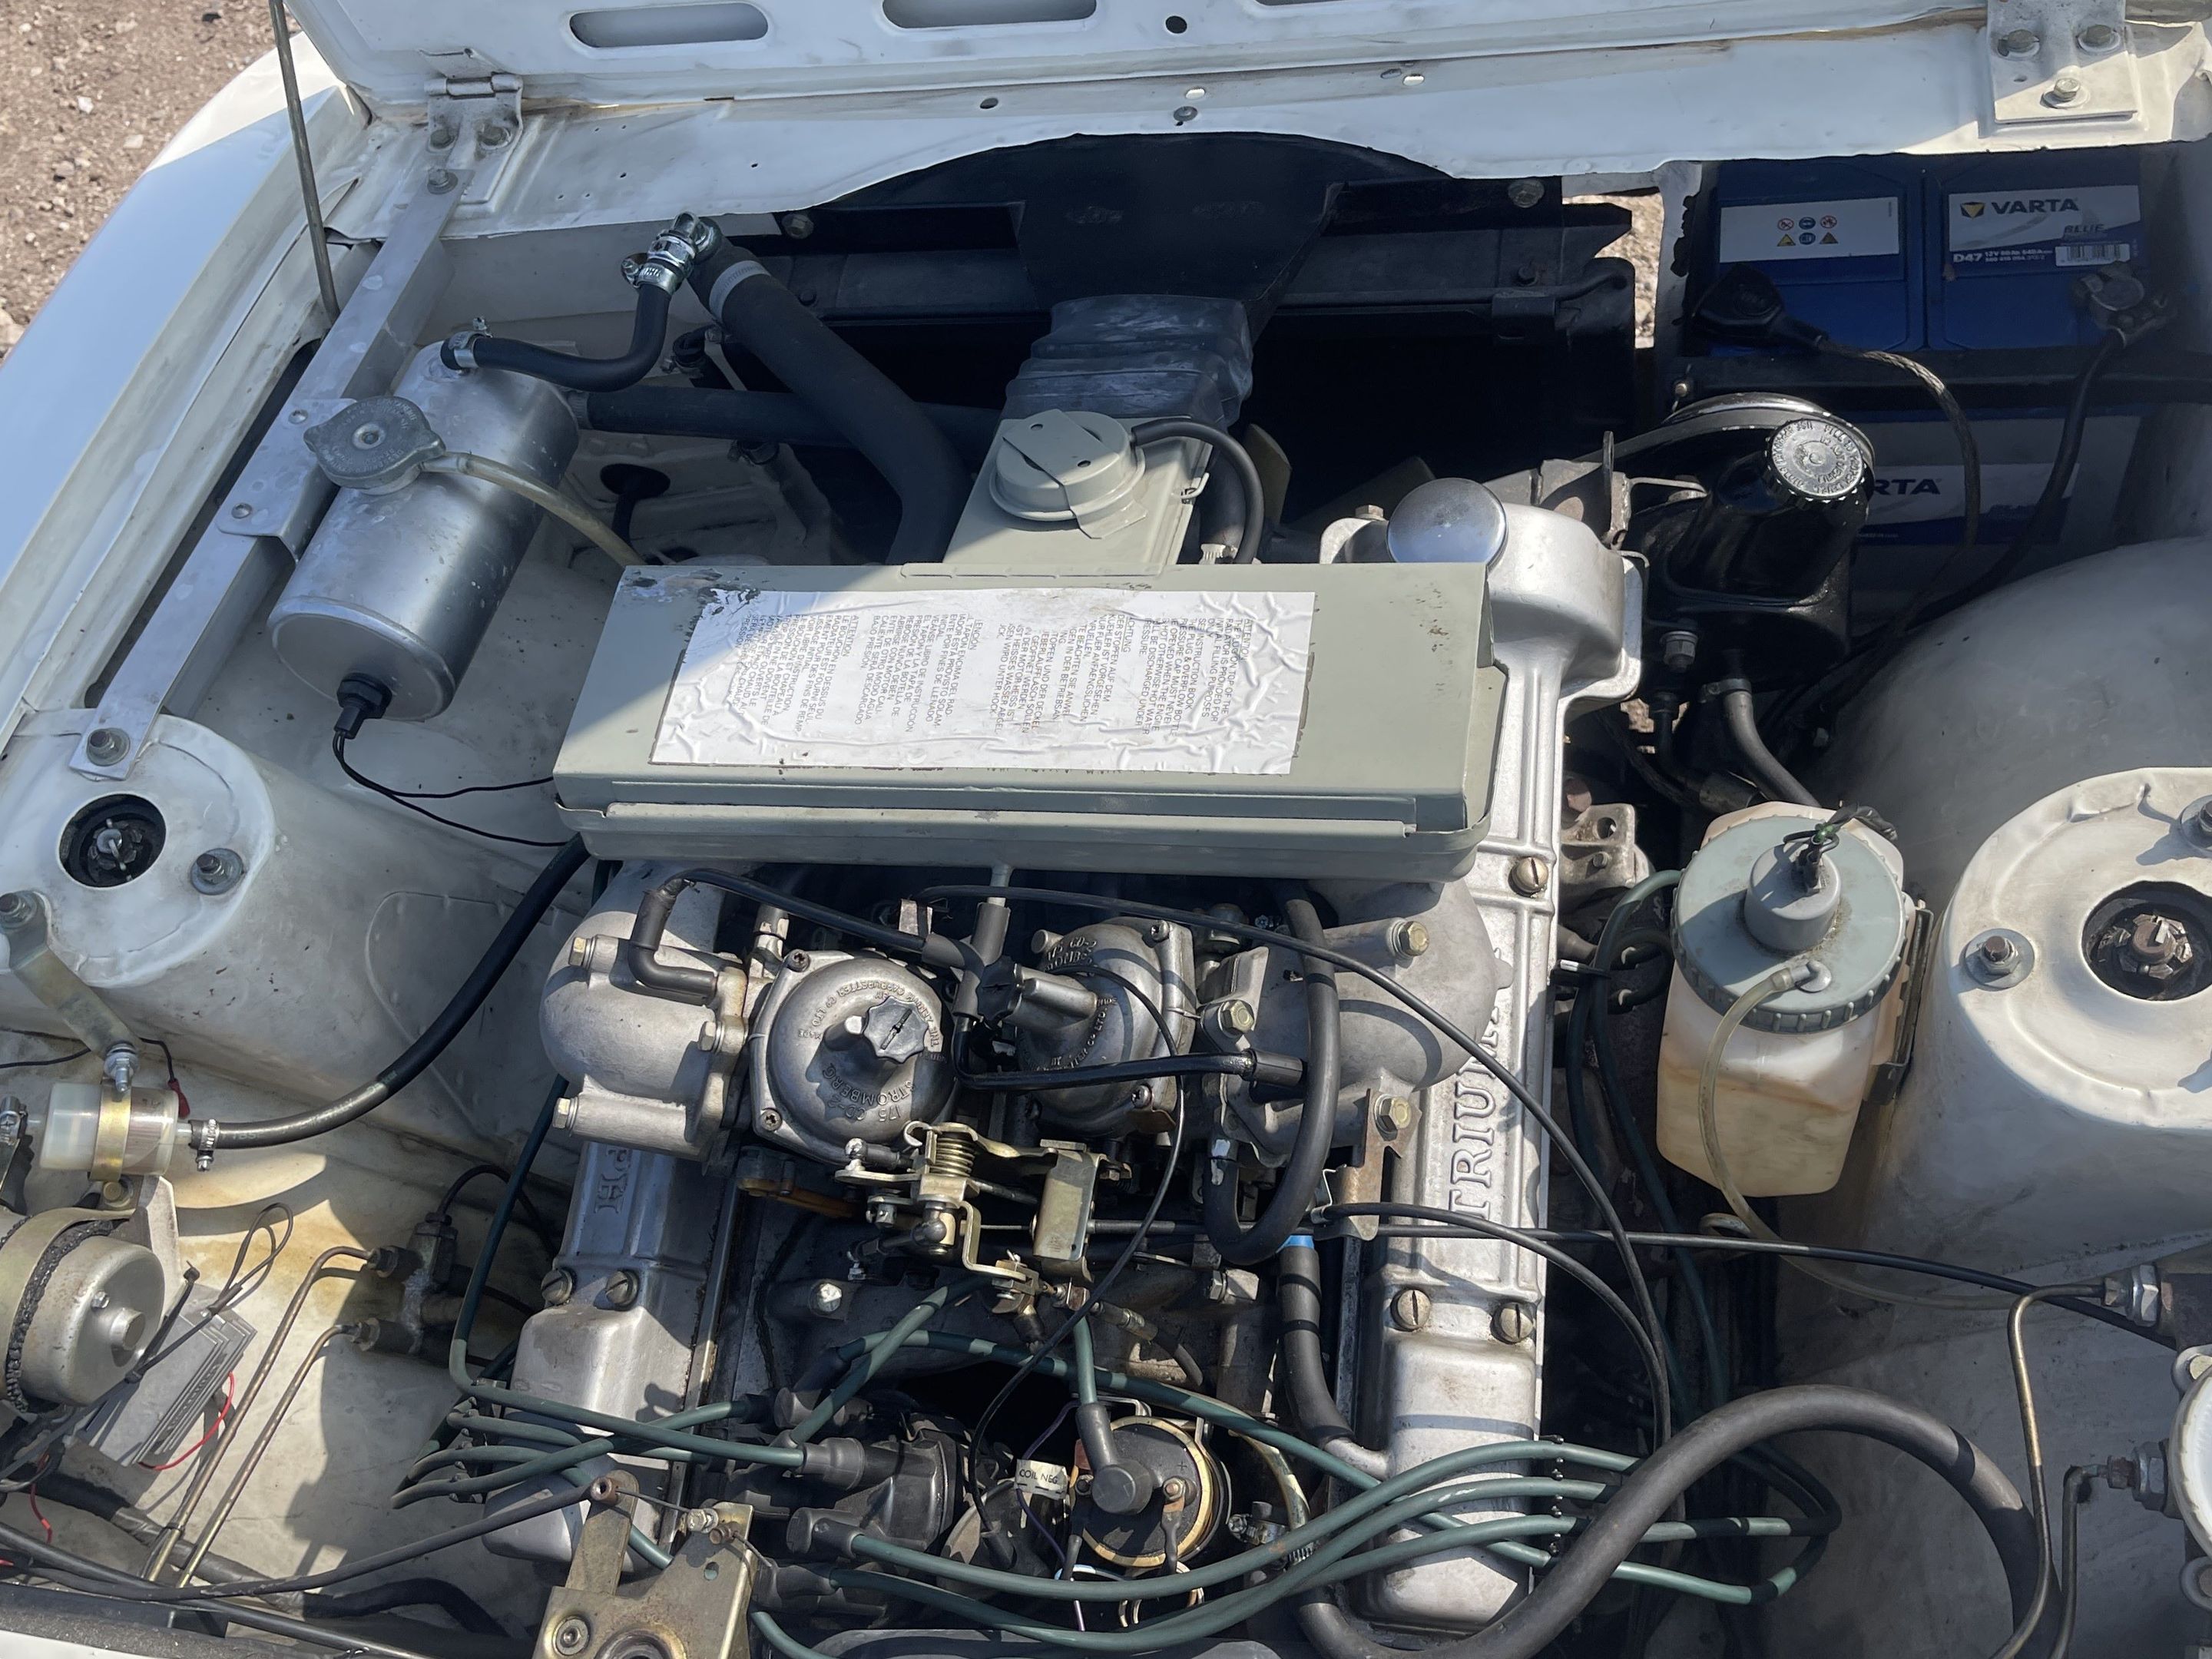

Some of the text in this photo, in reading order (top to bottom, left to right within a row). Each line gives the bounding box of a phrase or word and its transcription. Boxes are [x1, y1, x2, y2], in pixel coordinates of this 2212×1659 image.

[1991, 198, 2079, 214] VARTA
[1953, 253, 1982, 263] D47
[1872, 478, 1940, 495] RTA
[784, 614, 799, 648] PRESSION
[800, 614, 816, 651] VOIR LIBRE
[810, 614, 824, 644] LISSAGE
[843, 615, 859, 656] ATTENTION
[869, 615, 879, 634] BAJO
[955, 614, 965, 635] IADOR
[780, 651, 788, 660] DE
[790, 624, 804, 660] BOUCHON
[812, 615, 841, 700] RADIATEUR EST FOURNI
[832, 626, 846, 661] BOUCHON
[880, 615, 906, 693] ABRIRSE CON MOTOR
[888, 615, 913, 700] REBOSE NUNCA DEBEN
[1103, 614, 1124, 701] DER STOPFEN AUF DEM
[1186, 633, 1194, 654] PLUG
[800, 614, 833, 708] EMENT POUR DES FINS DE
[827, 664, 836, 674] EN
[856, 615, 889, 724] CALIENTE DESCARGADO
[912, 658, 920, 667] LA
[918, 644, 932, 677] LIBRO DE
[926, 614, 957, 721] ENTE POR FINES DE LLENADO
[941, 658, 955, 696] PROVISTO
[953, 650, 965, 679] ENCIMA
[995, 642, 1011, 690] WIRD UNTER
[1001, 639, 1020, 704] HEISSES WASSER
[1009, 637, 1029, 706] DER MOTOR HEISS
[1018, 635, 1038, 708] GEOFFNET WERDEN
[1061, 656, 1071, 671] DER
[1068, 635, 1084, 688] BEACHTEN SIE
[1081, 614, 1106, 721] NUR FUER ANFAENGSLICHEN
[1091, 614, 1115, 714] KUEHLER IST VORGESEHEN
[1147, 625, 1168, 707] HOT OTHERWISE HOT
[1157, 628, 1177, 701] OPENED WHEN THE
[1185, 633, 1204, 710] INSTRUCTION BOOK
[1210, 646, 1220, 674] FILLING
[1228, 656, 1237, 667] ON
[753, 661, 769, 695] OUVERTS
[761, 656, 779, 699] NE DOIVENT
[775, 673, 790, 707] CHAPEAU
[819, 676, 833, 706] DESSUS
[866, 637, 891, 719] DE OTRO MODO AGUA
[892, 648, 914, 716] DE LA BOTELLA DE
[908, 669, 918, 690] TAPA
[949, 682, 959, 696] DEL
[1136, 635, 1157, 725] BE DISCHARGED UNDER
[1169, 658, 1181, 698] CAP MUST
[1177, 664, 1189, 707] OVERFLOW
[1214, 666, 1225, 704] PROVIDED
[1224, 687, 1232, 697] OF
[1226, 671, 1234, 684] TOP
[815, 708, 823, 719] DU
[904, 692, 912, 702] DE
[1032, 664, 1051, 729] UND DER DECKEL
[1210, 706, 1219, 721] FOR
[1221, 699, 1230, 714] THE
[761, 715, 770, 724] DE
[1022, 704, 1034, 733] SOLLEN
[822, 1062, 913, 1107] STROMBERG
[826, 1094, 901, 1122] 175 CD-2
[1019, 1469, 1038, 1479] COIL
